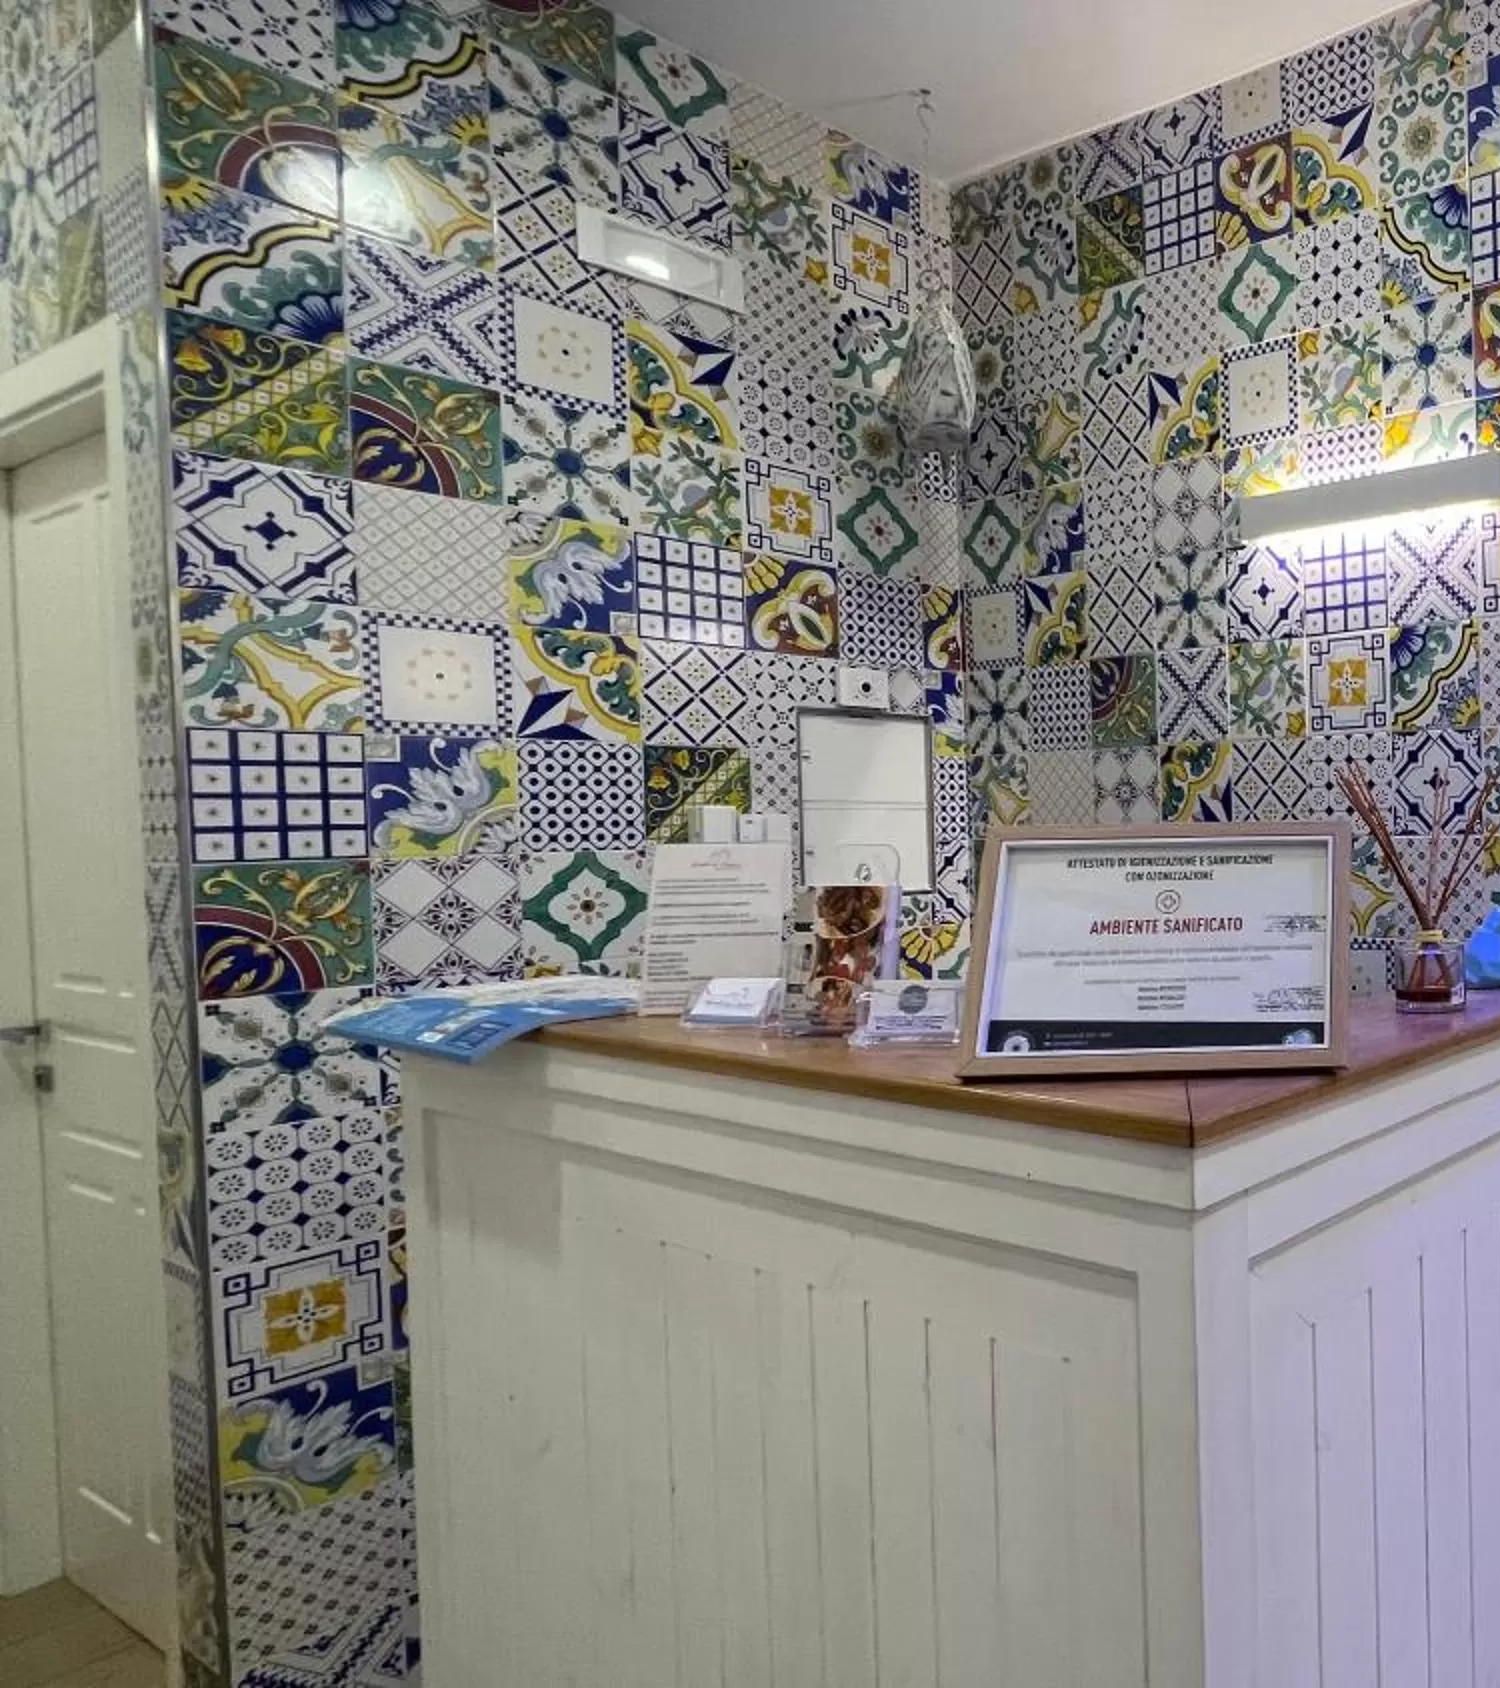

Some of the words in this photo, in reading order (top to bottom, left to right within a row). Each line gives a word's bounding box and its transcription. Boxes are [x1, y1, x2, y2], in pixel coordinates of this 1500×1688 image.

[1067, 857, 1116, 869] ATTESTATO
[1117, 856, 1127, 867] DI
[1208, 853, 1274, 866] SANIFICAZIONE
[1125, 870, 1145, 882] CON
[1089, 918, 1160, 935] AMBIENTE
[1163, 916, 1243, 934] SANIFICATO
